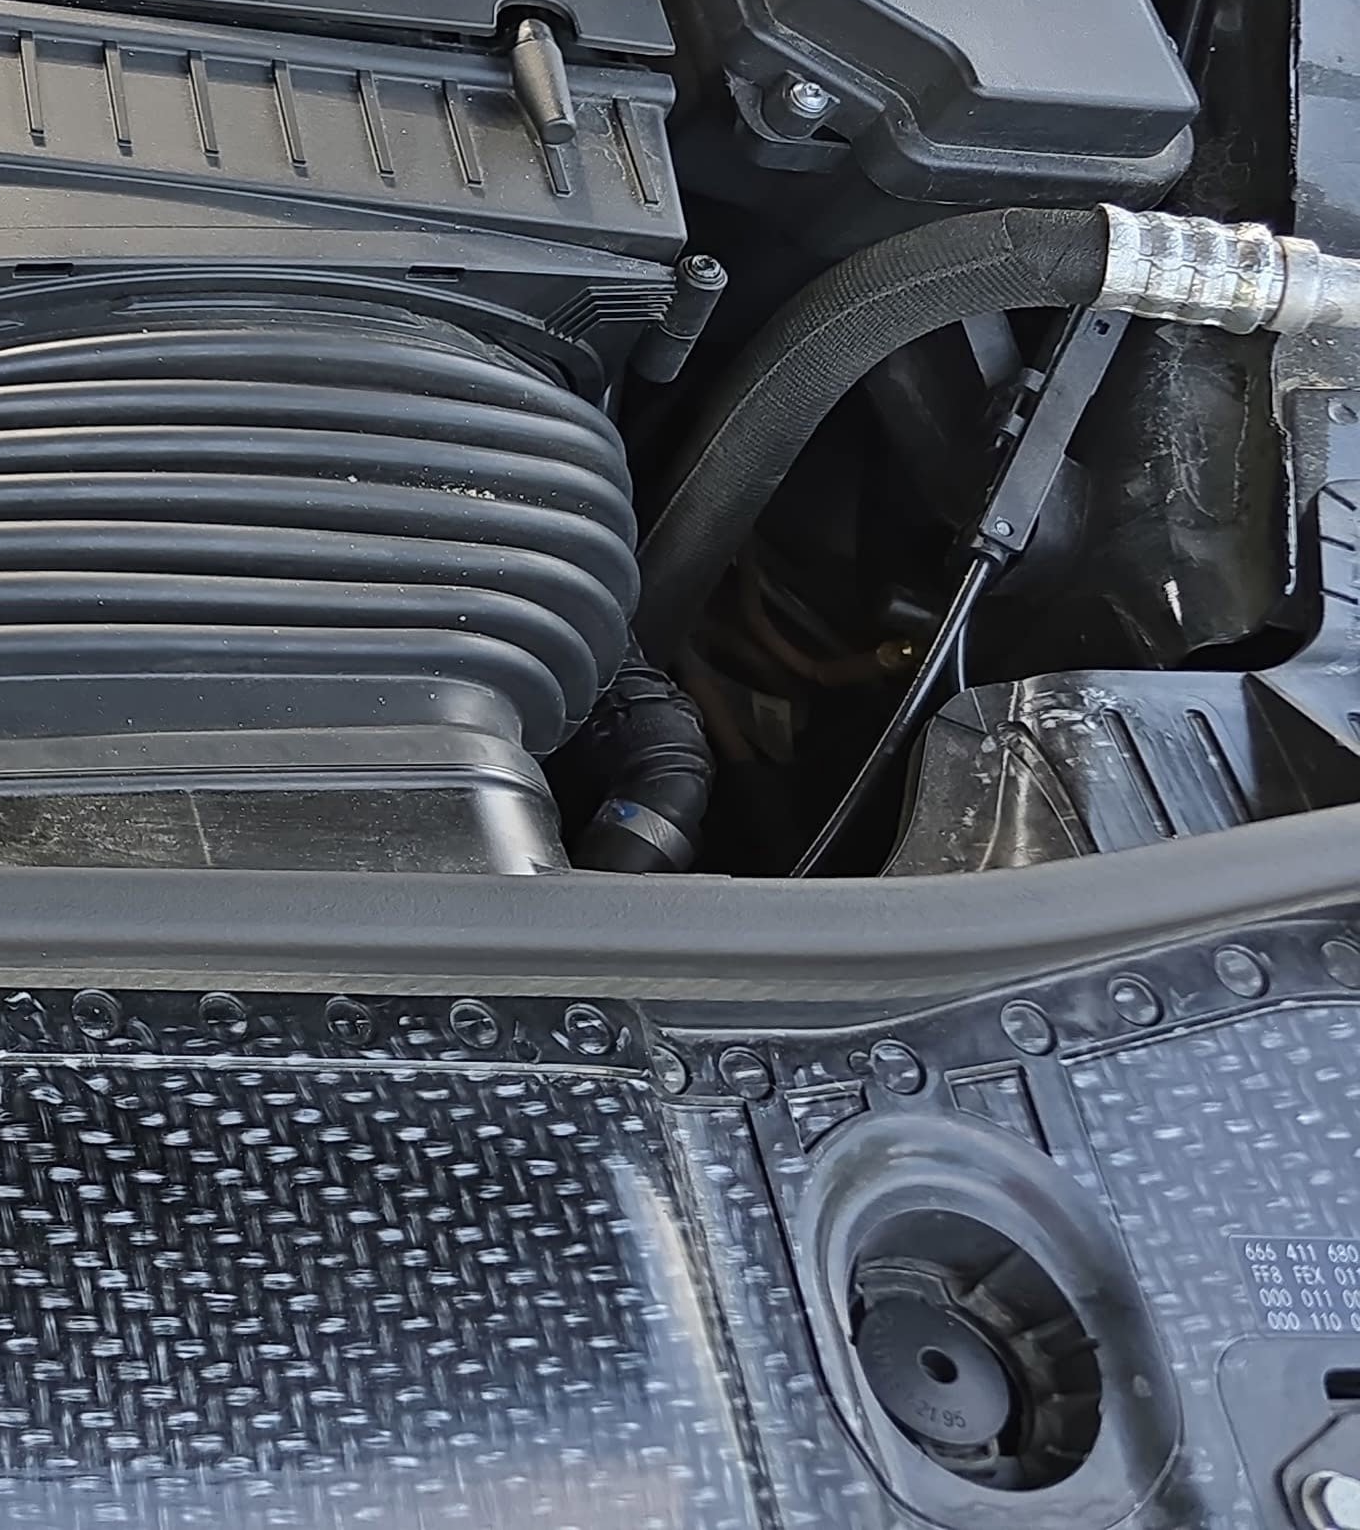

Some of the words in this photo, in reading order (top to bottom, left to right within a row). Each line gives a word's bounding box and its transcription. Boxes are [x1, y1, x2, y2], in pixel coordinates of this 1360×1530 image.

[1245, 1242, 1277, 1261] 666
[1286, 1243, 1317, 1261] 411
[1328, 1244, 1359, 1263] 680
[1259, 1288, 1292, 1307] 000
[1301, 1289, 1332, 1307] 011
[1268, 1311, 1300, 1330] 000
[1310, 1312, 1342, 1331] 110
